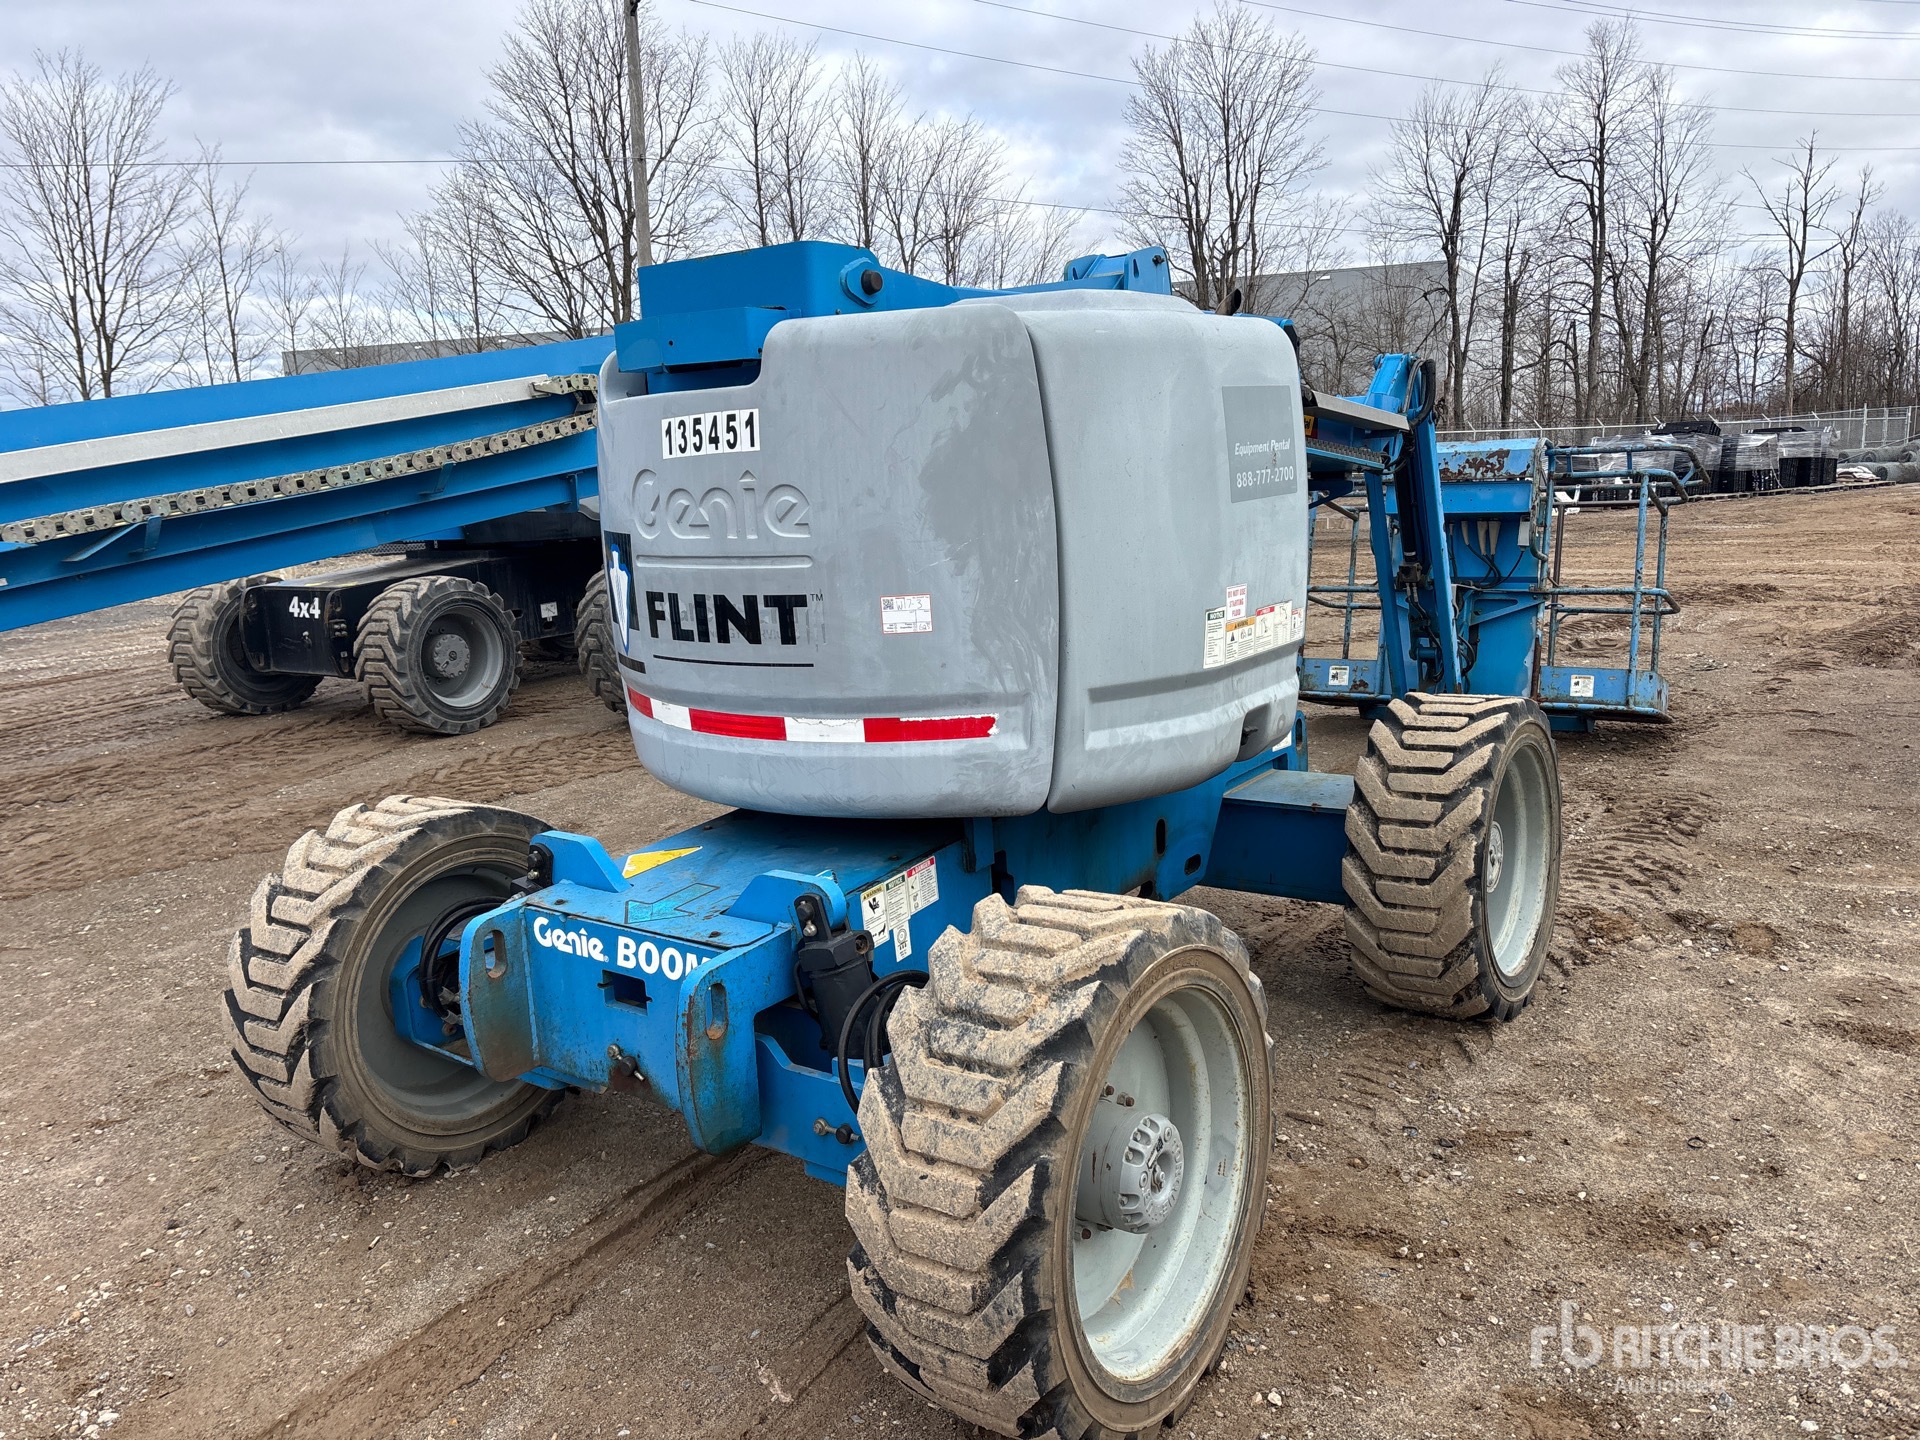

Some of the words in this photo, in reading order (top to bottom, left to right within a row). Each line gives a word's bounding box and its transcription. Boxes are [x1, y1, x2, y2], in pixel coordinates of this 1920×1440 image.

[665, 411, 755, 456] 135451
[1234, 441, 1269, 457] Equipment
[1236, 466, 1294, 488] 888-777-2700
[632, 468, 811, 540] Genie
[289, 596, 321, 619] 4x4
[1209, 611, 1224, 619] NOTICE
[646, 591, 808, 645] FLINT
[915, 860, 932, 873] DANGER
[866, 885, 883, 898] WARNING
[888, 876, 904, 888] NOTICE
